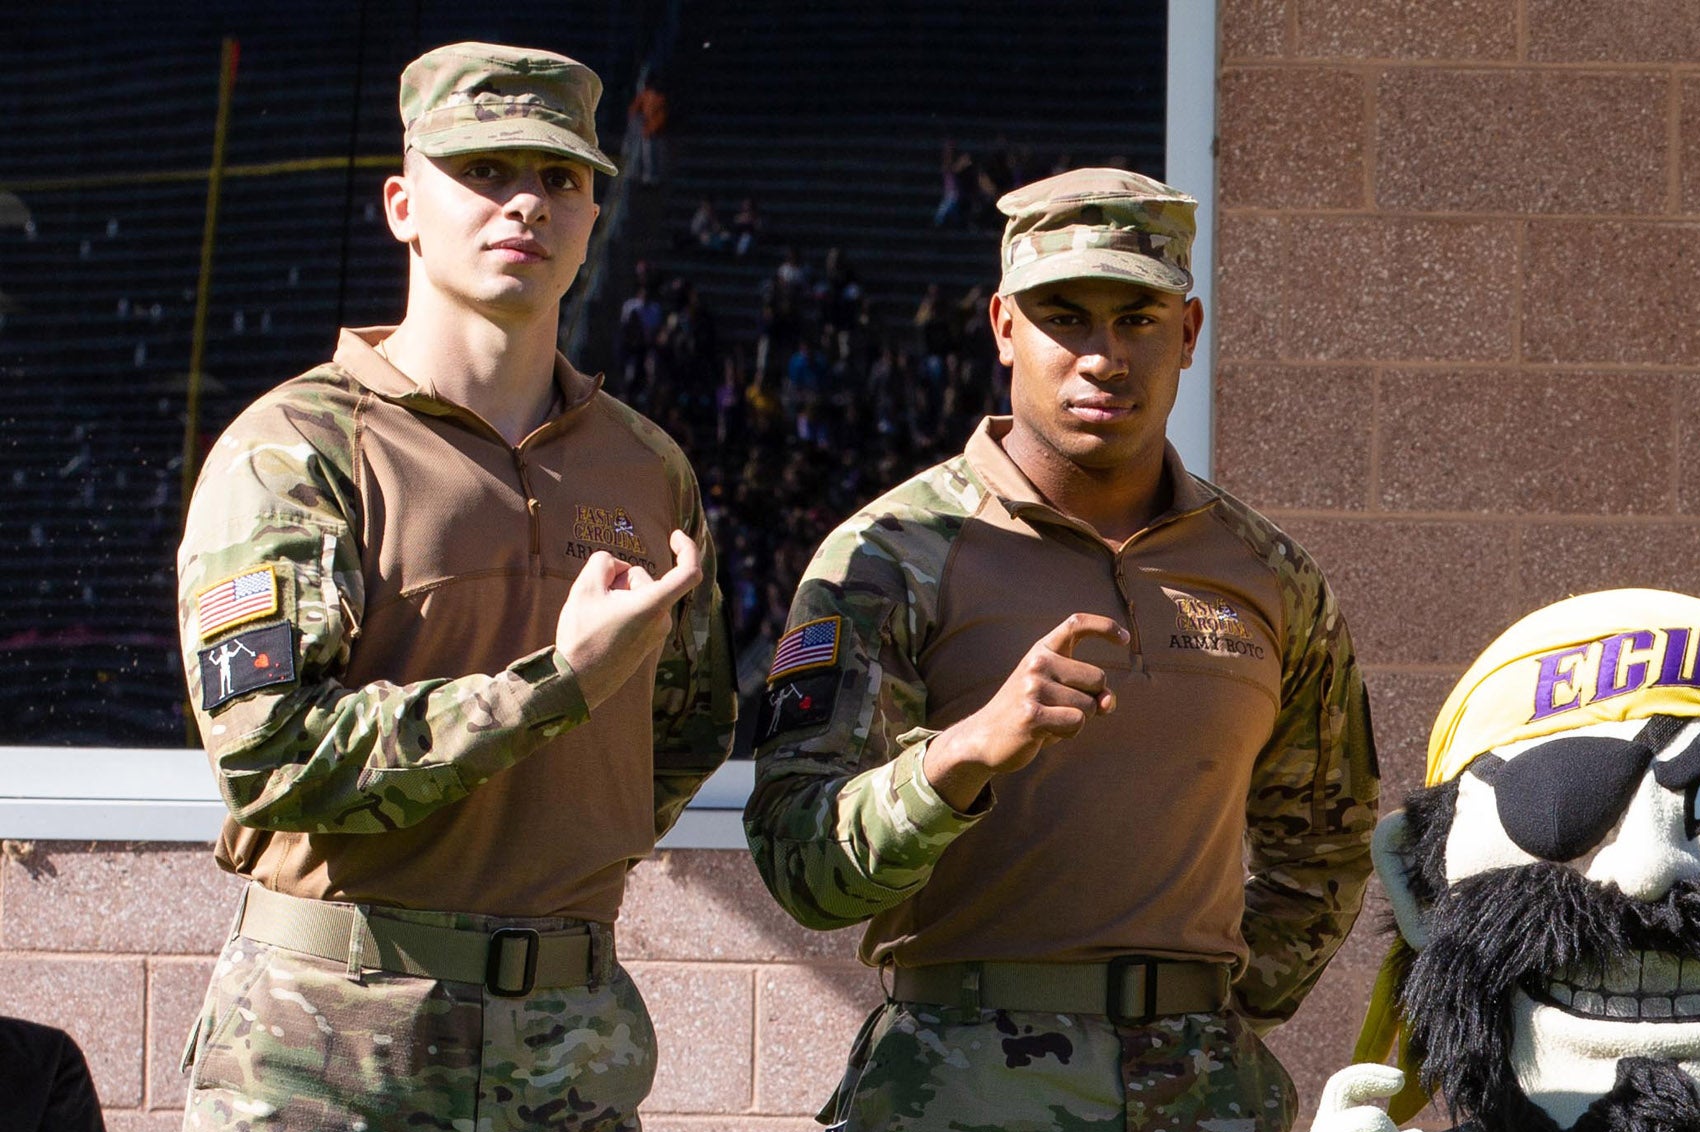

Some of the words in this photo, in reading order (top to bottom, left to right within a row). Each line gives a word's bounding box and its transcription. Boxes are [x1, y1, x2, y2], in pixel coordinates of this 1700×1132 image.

[575, 505, 614, 528] EAST
[573, 522, 647, 554] CAROLINA
[564, 541, 613, 561] AR
[1174, 599, 1216, 619] EAST
[1177, 615, 1251, 640] CAROLINA
[1169, 634, 1220, 650] ARMY
[1224, 639, 1264, 660] ROTC
